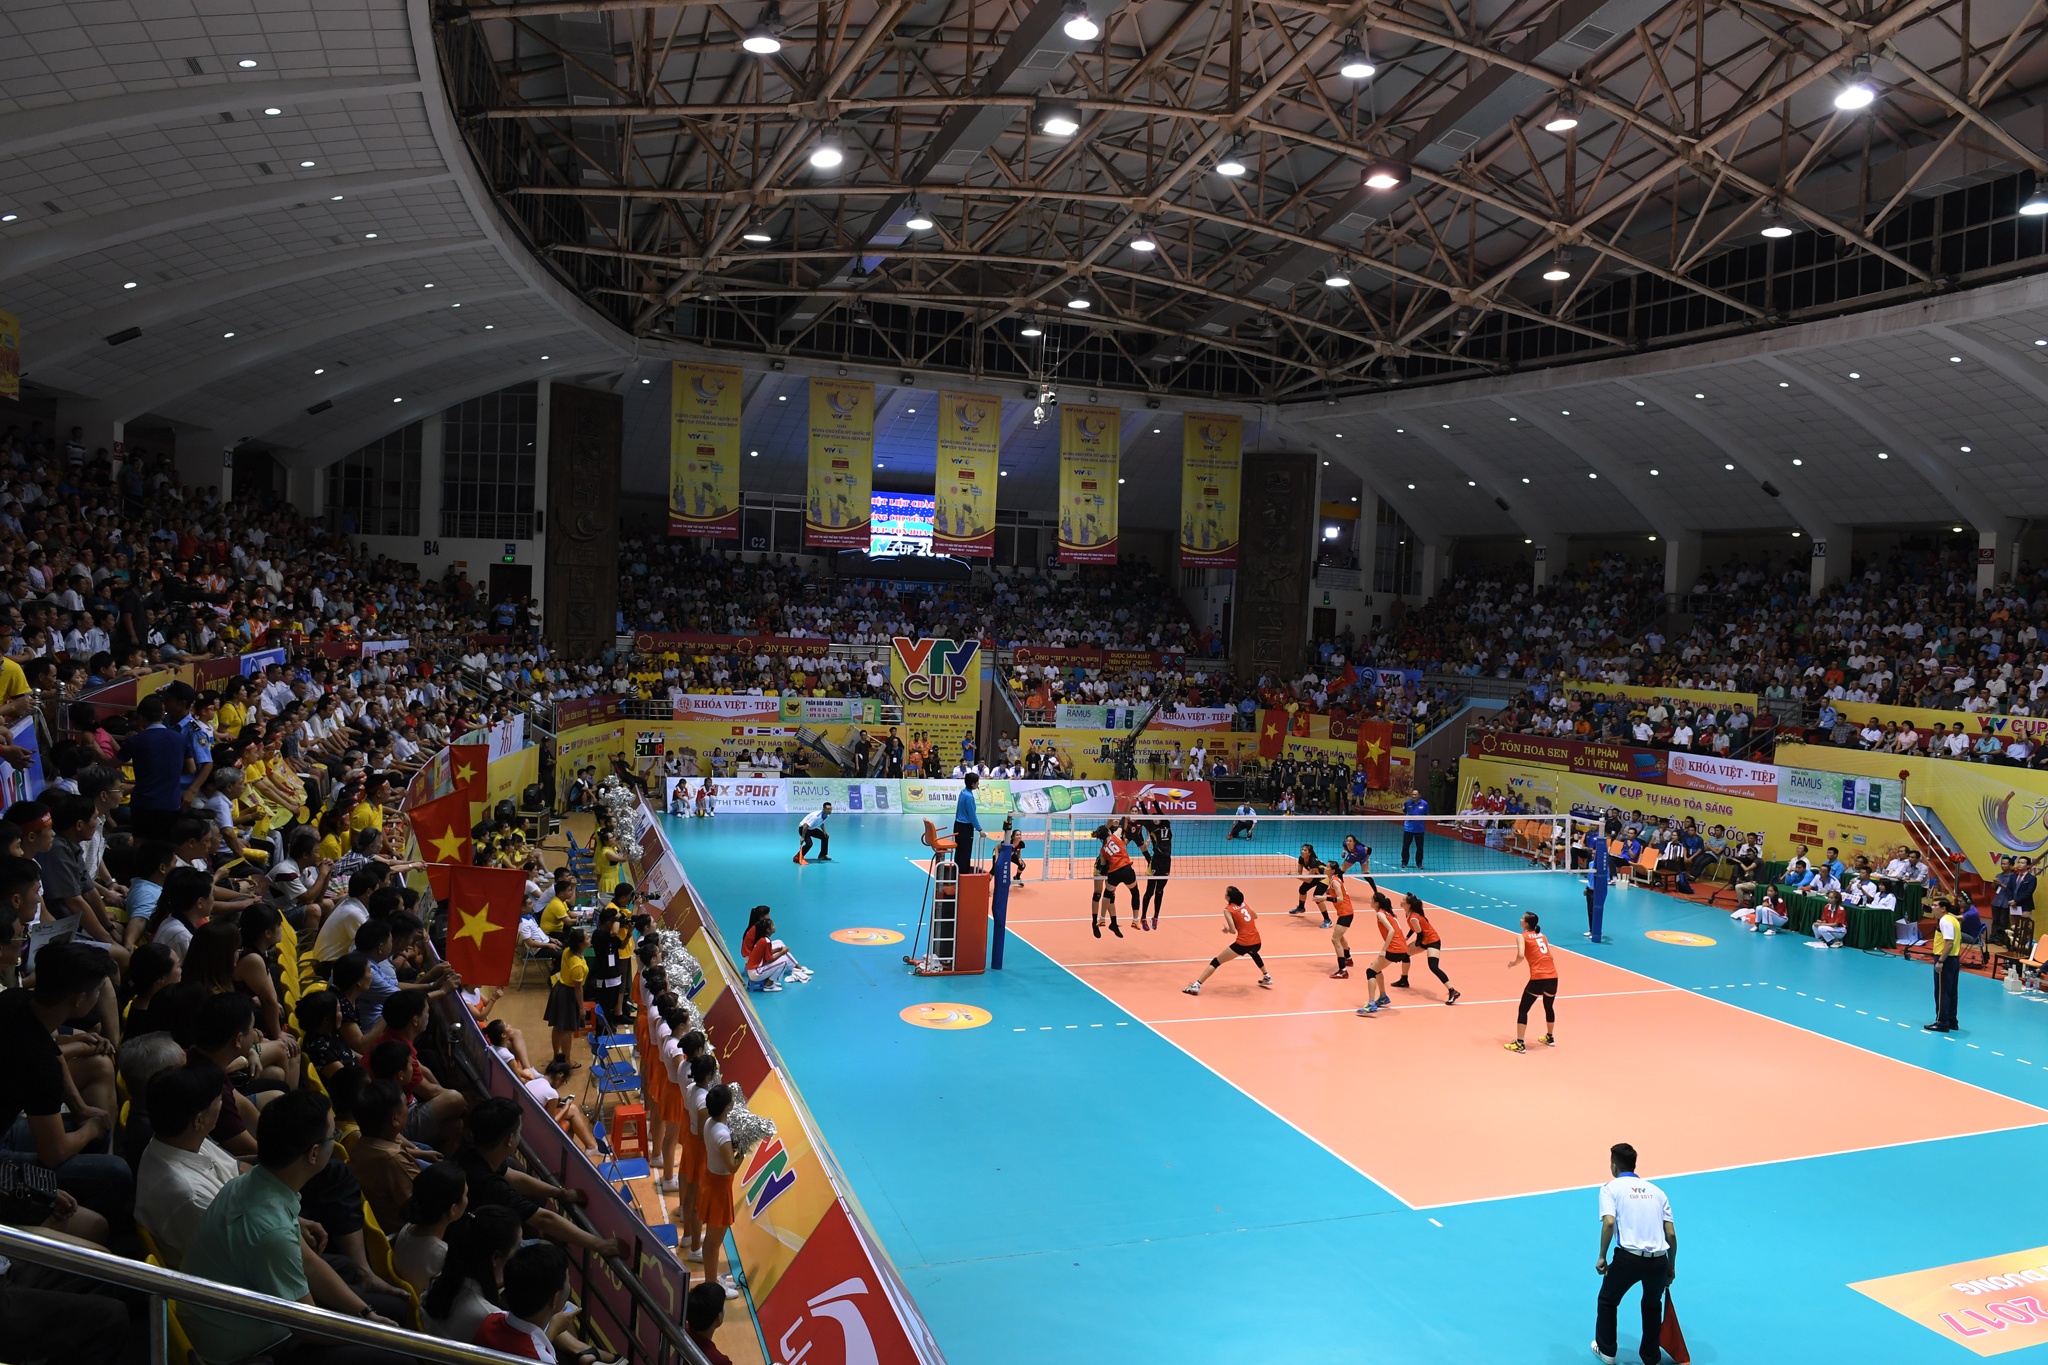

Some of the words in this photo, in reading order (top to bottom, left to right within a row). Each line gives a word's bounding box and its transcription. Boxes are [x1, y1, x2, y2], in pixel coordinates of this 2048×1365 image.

[424, 541, 440, 556] B4
[751, 537, 766, 548] C2
[1813, 543, 1826, 556] A2
[1536, 550, 1545, 560] A4
[892, 637, 980, 676] VTV
[903, 674, 968, 702] CUP
[694, 698, 722, 710] KHÓA
[724, 699, 746, 712] VIỆT
[754, 700, 778, 712] TIỆP
[1066, 710, 1092, 718] RAMUS
[1163, 710, 1188, 720] KHÓA
[1188, 711, 1206, 722] VIỆT
[1212, 712, 1230, 722] TIỆP
[1978, 716, 2009, 732] VTV
[2011, 718, 2048, 736] CUP
[636, 744, 648, 756] 21
[655, 744, 664, 756] 18
[1288, 743, 1301, 752] VTV
[1302, 745, 1318, 754] CUP
[1500, 740, 1521, 753] TÔN
[1524, 744, 1545, 756] HOA
[1548, 748, 1568, 759] SEN
[1584, 746, 1596, 758] THỊ
[1597, 747, 1619, 759] PHẦN
[1574, 756, 1585, 766] SỐ
[1593, 758, 1608, 769] VIỆT
[1609, 762, 1629, 772] NAM
[1688, 760, 1717, 774] KHÓA
[1719, 765, 1744, 782] VIỆT
[1751, 770, 1776, 785] TIỆP
[1509, 777, 1524, 787] VTV
[1790, 776, 1822, 790] RAMUS
[735, 785, 779, 798] SPORT
[793, 786, 830, 796] RAMUS
[734, 798, 750, 806] THỂ
[1598, 783, 1619, 796] VTV
[1620, 786, 1643, 800] CUP
[1646, 793, 1659, 806] TỰ
[1660, 796, 1681, 807] HÀO
[1683, 797, 1703, 810] TỎA
[1705, 803, 1733, 816] SÁNG
[1160, 827, 1168, 838] 17
[1104, 841, 1120, 856] 16
[1240, 908, 1252, 922] 3
[1536, 938, 1548, 954] 5
[1938, 1296, 2048, 1338] 2017
